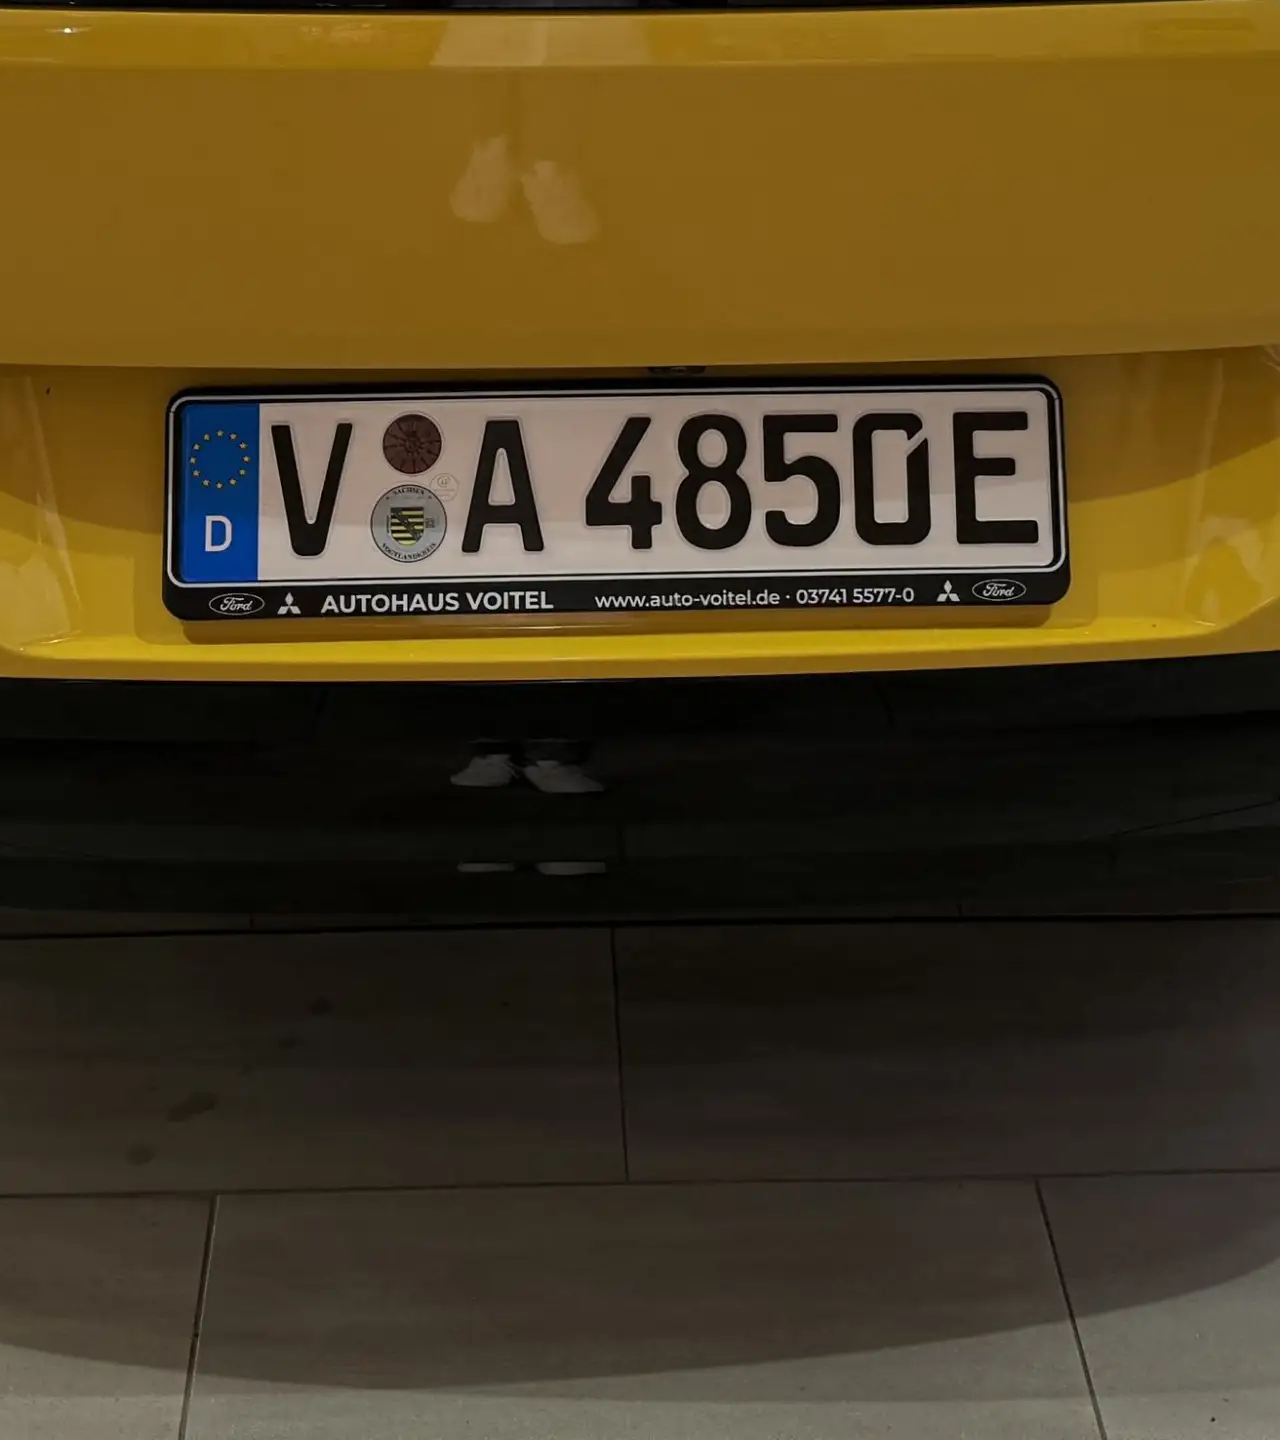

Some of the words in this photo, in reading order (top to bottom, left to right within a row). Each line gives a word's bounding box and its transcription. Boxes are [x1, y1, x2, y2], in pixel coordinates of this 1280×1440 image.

[205, 514, 233, 554] D
[271, 422, 353, 558] V
[462, 419, 545, 554] A
[583, 410, 1040, 552] 4850E
[219, 596, 254, 613] Ford
[321, 592, 460, 614] AUTOHAUS
[466, 590, 555, 612] VOITEL
[595, 588, 780, 609] www.auto-voitel.de
[796, 587, 848, 605] 03741
[852, 586, 915, 605] 5577-0
[982, 581, 1017, 600] Ford
